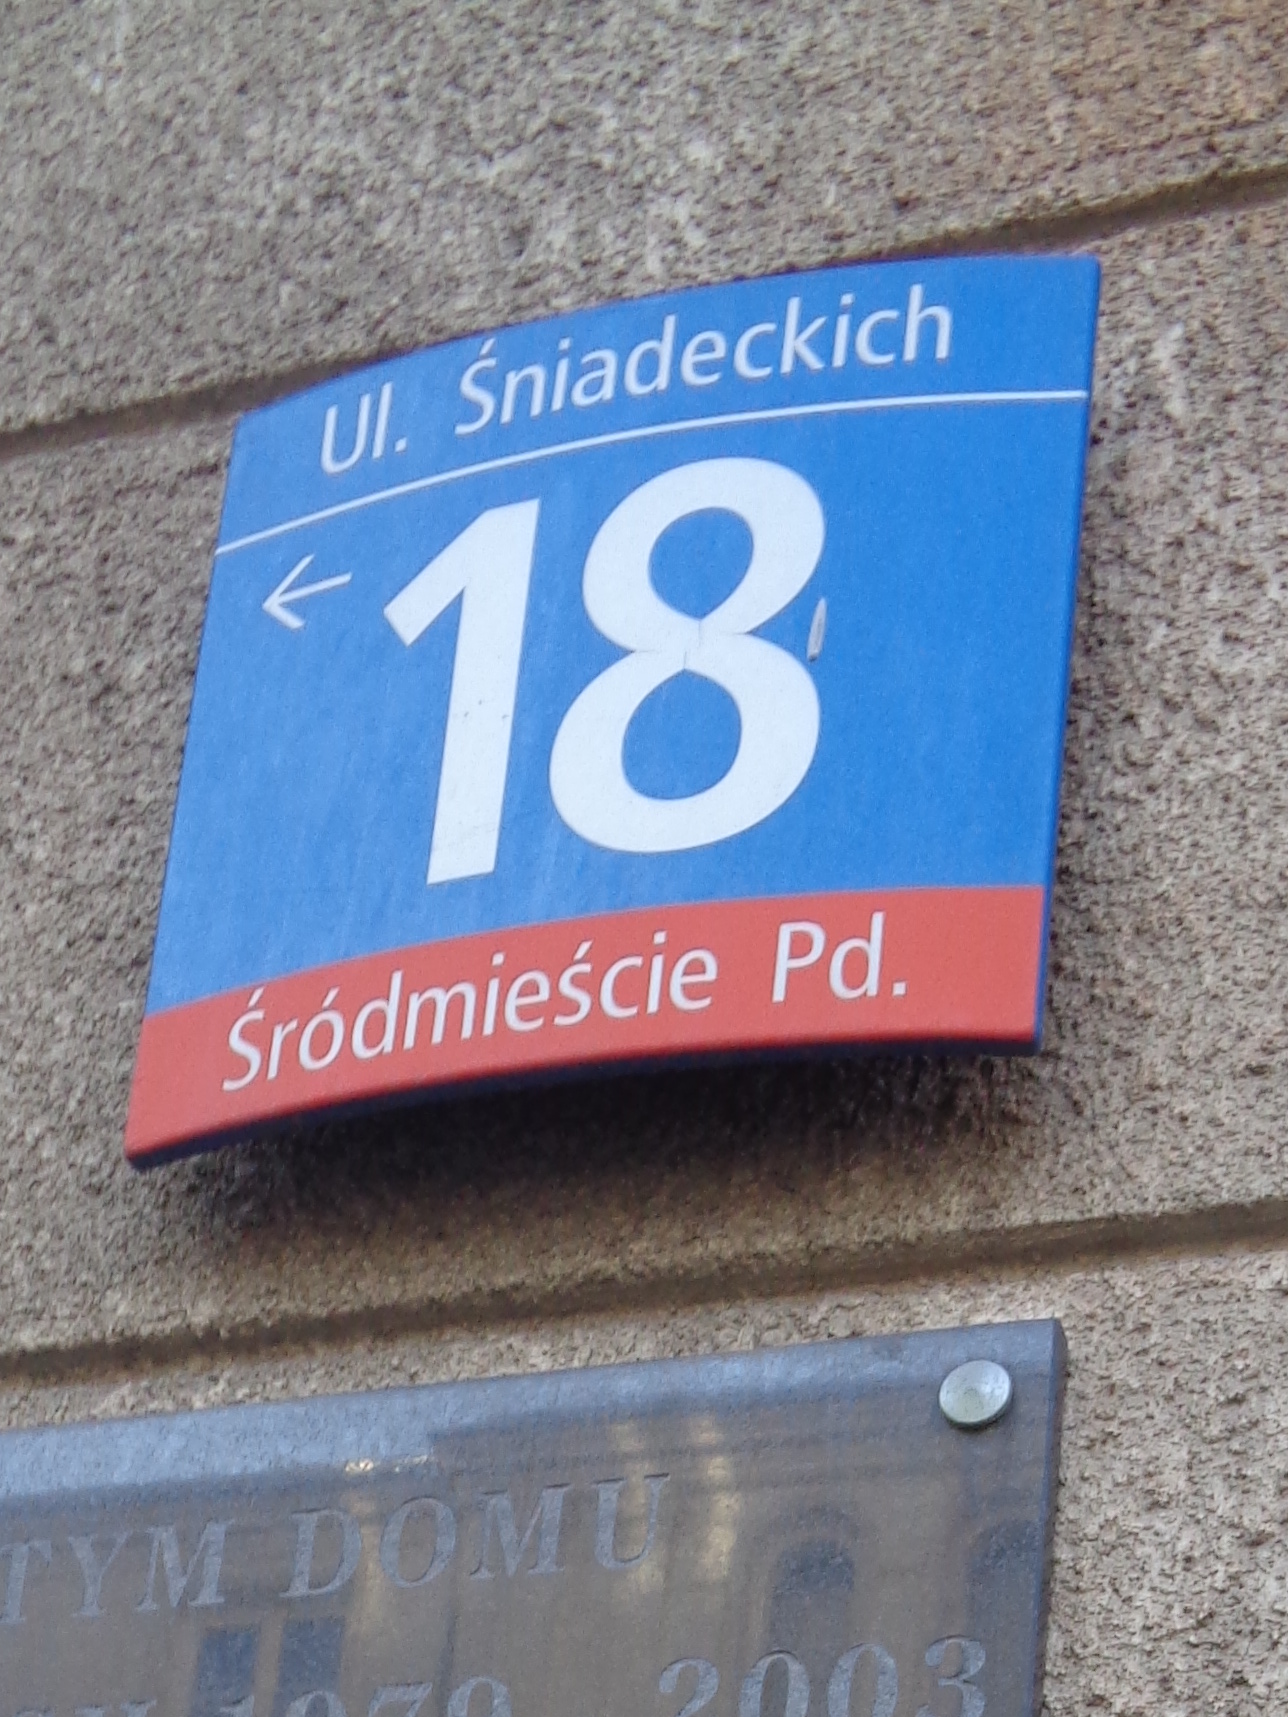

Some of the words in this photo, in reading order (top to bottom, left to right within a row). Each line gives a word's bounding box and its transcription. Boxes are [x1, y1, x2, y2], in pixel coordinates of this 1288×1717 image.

[318, 388, 407, 476] Ul.
[455, 283, 954, 437] Śniadeckich
[382, 455, 826, 885] 18
[220, 929, 718, 1092] Śródmieście
[771, 909, 909, 1003] Pd.
[280, 1472, 672, 1598] DOMU
